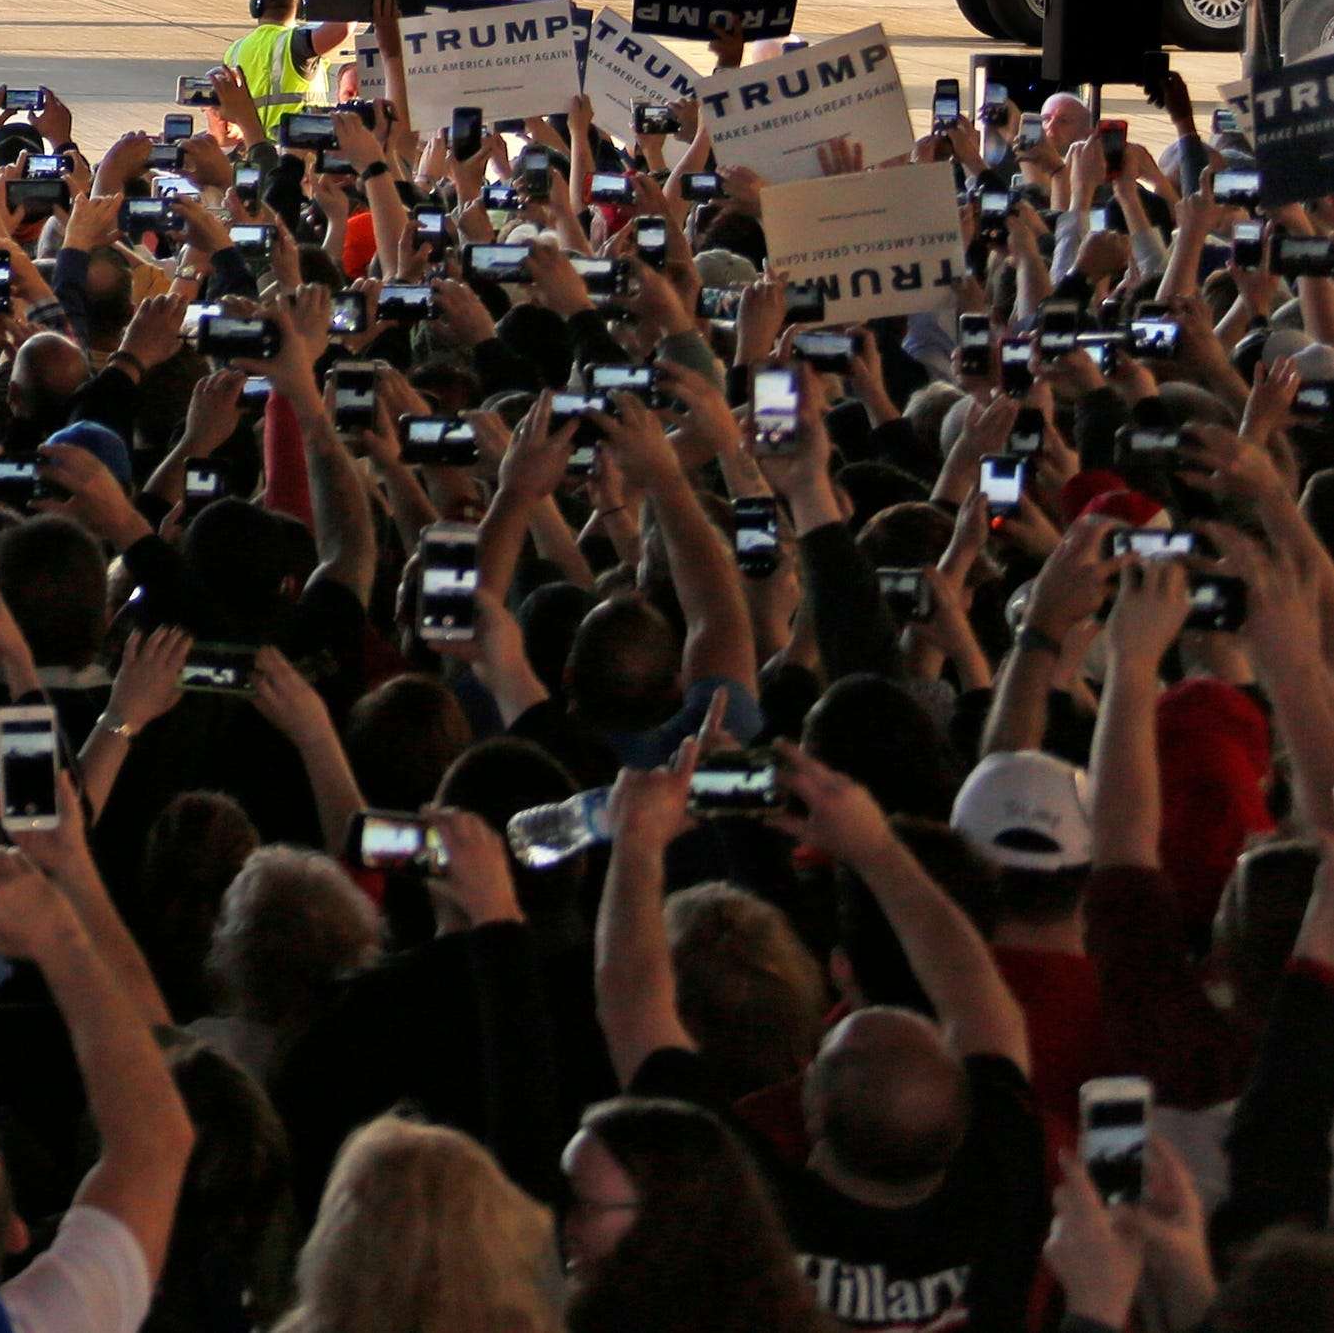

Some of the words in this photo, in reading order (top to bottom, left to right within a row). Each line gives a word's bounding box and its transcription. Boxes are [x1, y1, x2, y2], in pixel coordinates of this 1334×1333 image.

[404, 16, 569, 54] TRUMP
[408, 65, 439, 76] MAKE
[442, 58, 492, 71] AMERICA
[496, 54, 531, 67] GREAT
[535, 49, 572, 62] AGAIN!
[589, 49, 606, 65] AKE
[605, 62, 648, 92] AMERICA
[649, 89, 669, 105] GRE
[596, 19, 698, 99] TRUM
[703, 43, 889, 118] TRUMP
[713, 126, 747, 143] MAKE
[753, 109, 811, 133] AMERICA
[814, 95, 853, 115] GREAT
[853, 235, 915, 255] AMERICA
[789, 258, 963, 301] TRUM
